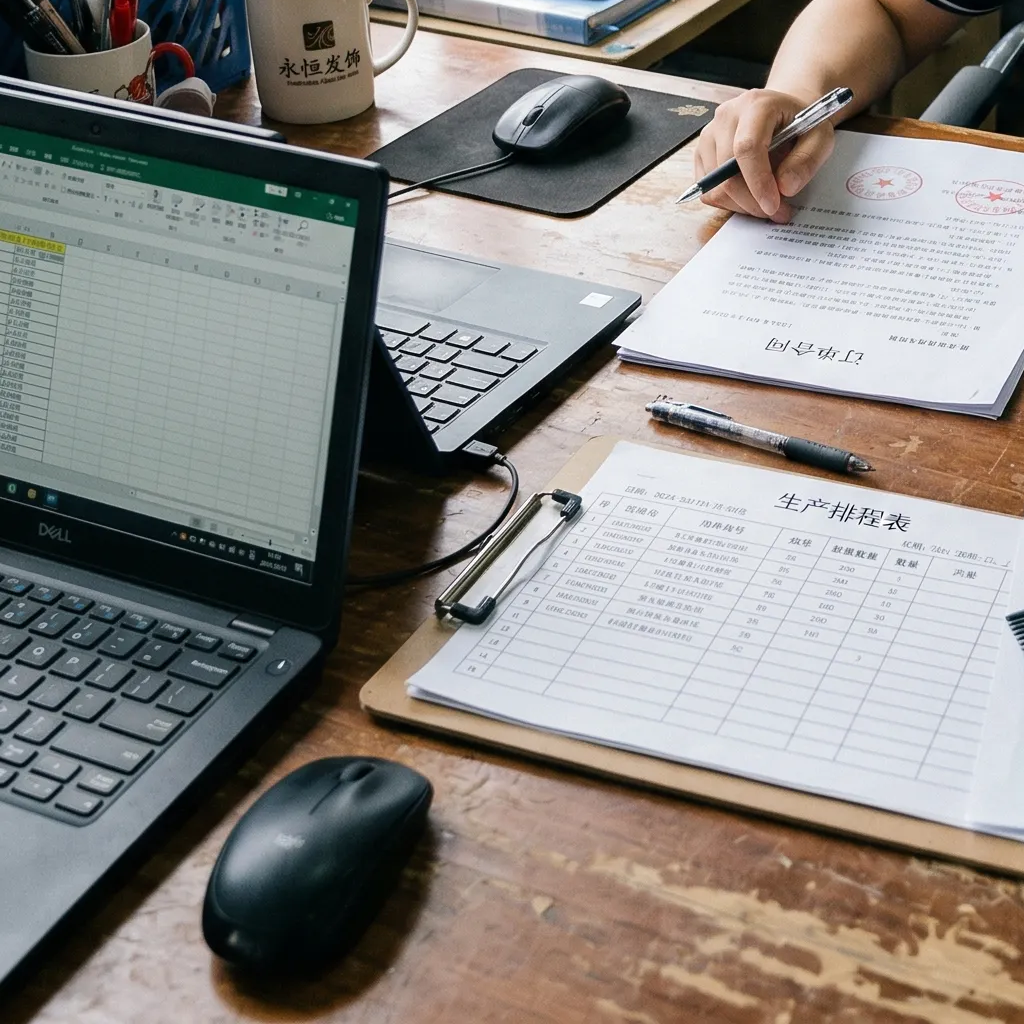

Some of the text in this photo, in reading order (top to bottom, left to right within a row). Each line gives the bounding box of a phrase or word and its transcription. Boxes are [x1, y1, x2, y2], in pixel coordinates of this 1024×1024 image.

[278, 48, 361, 79] 永恒发饰
[764, 336, 866, 366] 订单合同
[774, 492, 912, 533] 生产排程表
[38, 522, 72, 544] DELL
